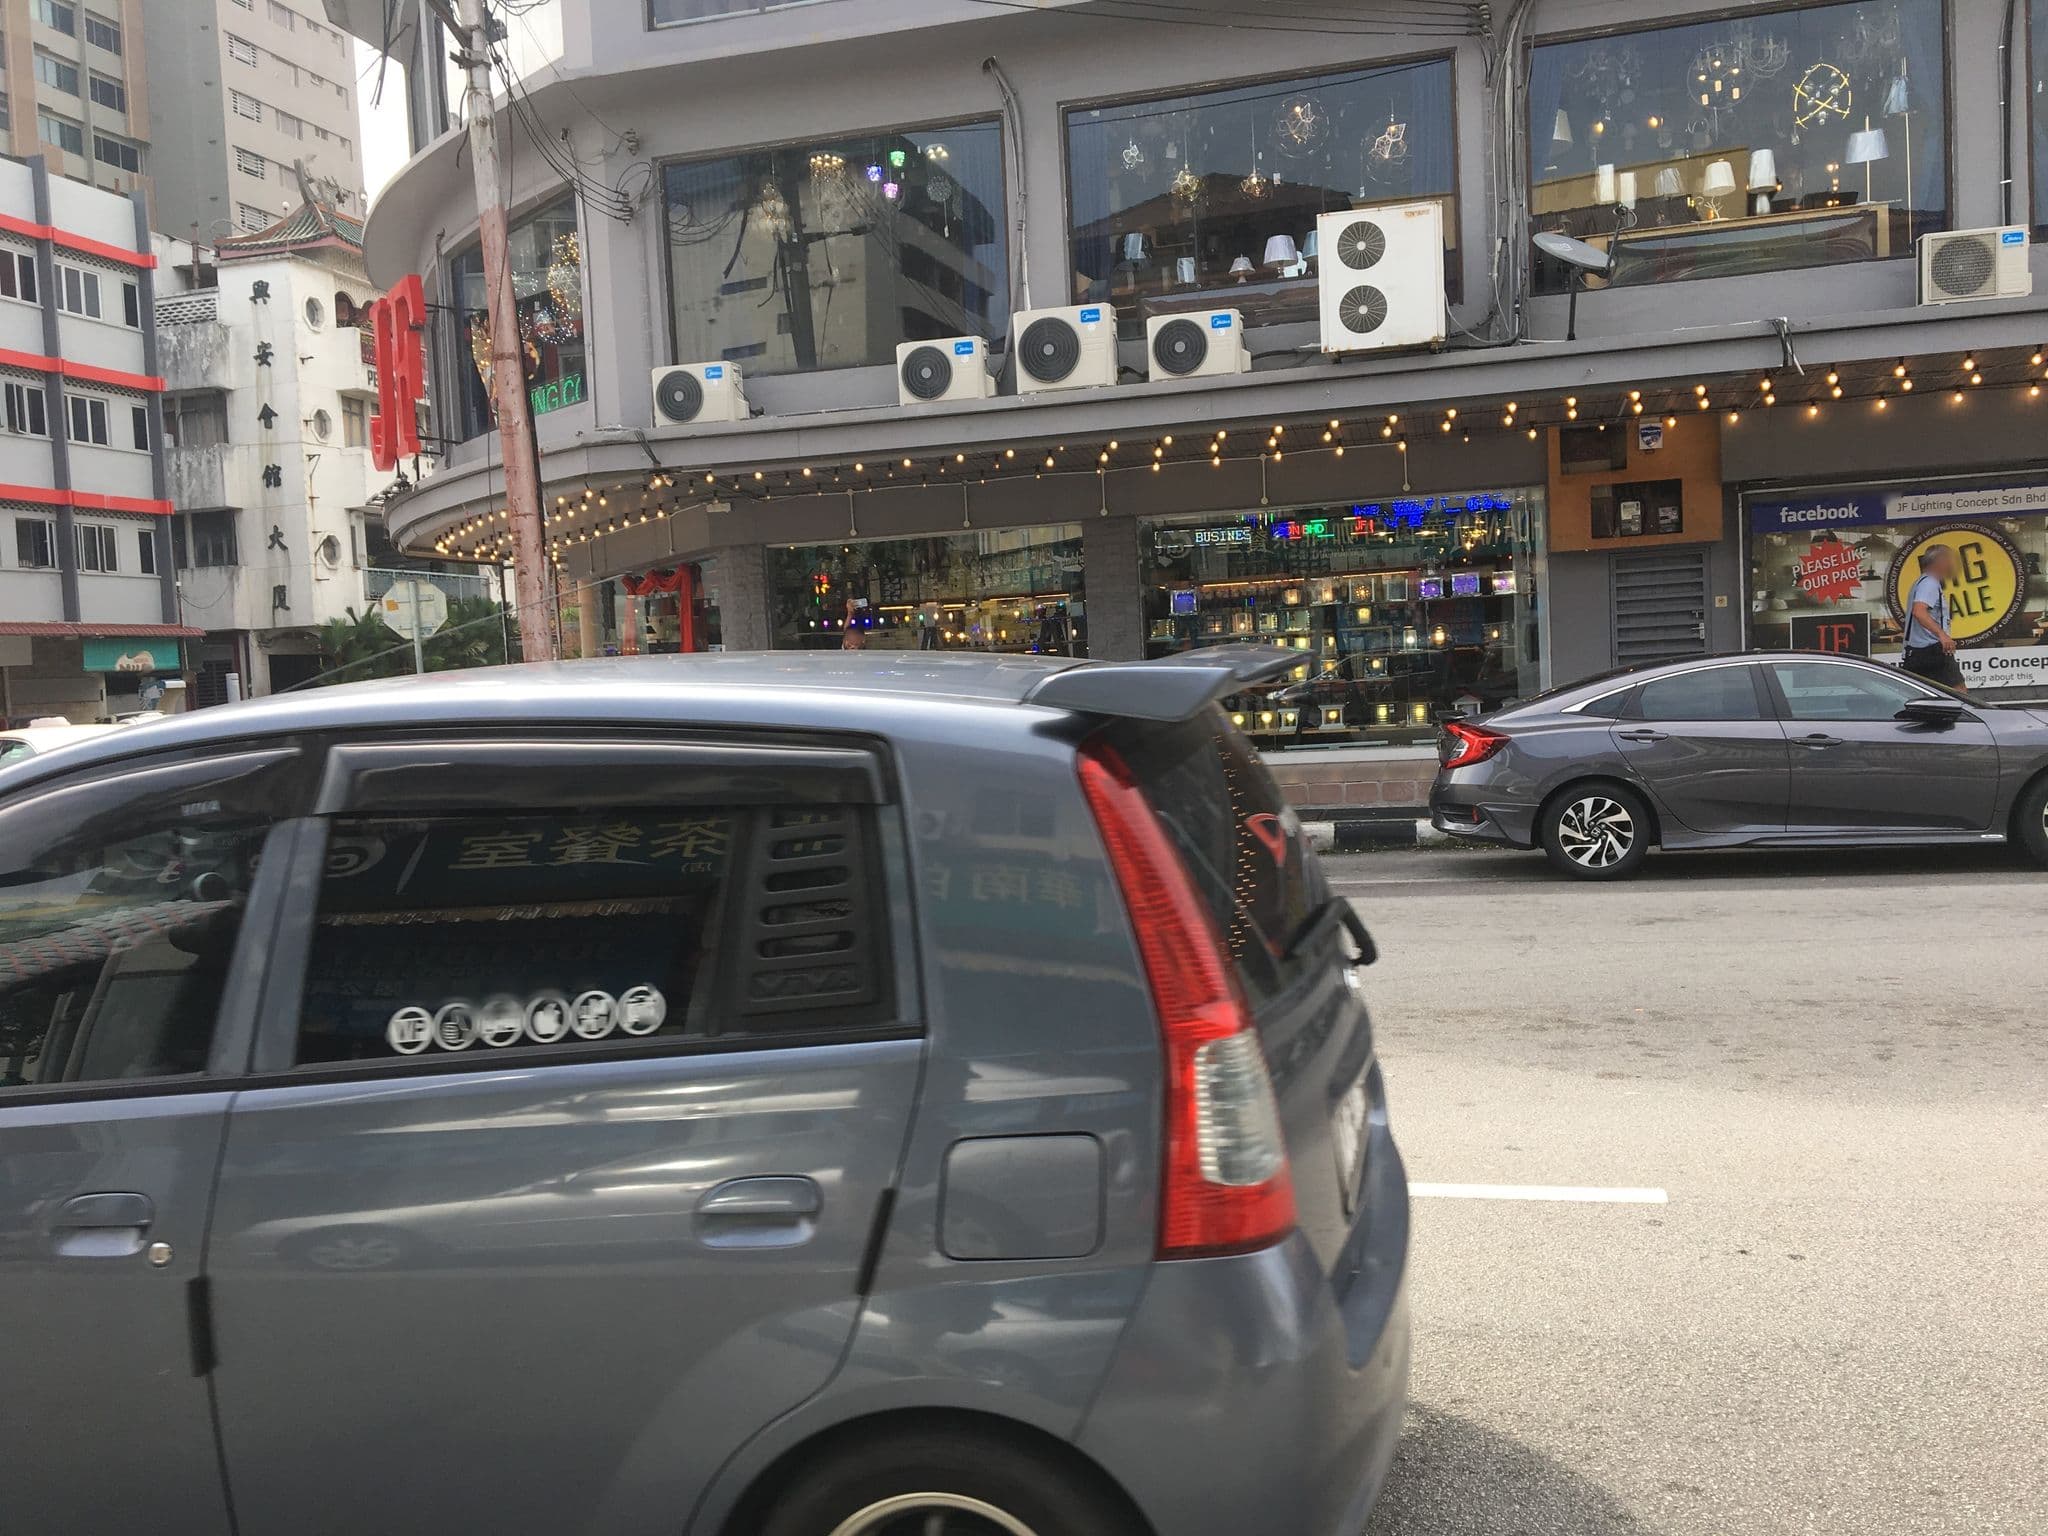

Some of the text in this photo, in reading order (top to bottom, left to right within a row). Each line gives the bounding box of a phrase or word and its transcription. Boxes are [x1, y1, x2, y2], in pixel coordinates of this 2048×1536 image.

[369, 274, 426, 472] JF
[1780, 503, 1859, 524] facebook
[1911, 500, 1952, 513] Lighting
[1956, 497, 1998, 509] Concept
[2001, 495, 2022, 505] Sdn
[2025, 492, 2046, 503] Bhd
[1792, 547, 1867, 579] PLEASE LIKE
[1803, 565, 1865, 593] OUR PAGE
[1949, 584, 1995, 620] ALE
[1989, 672, 2014, 681] about
[2017, 671, 2034, 680] this
